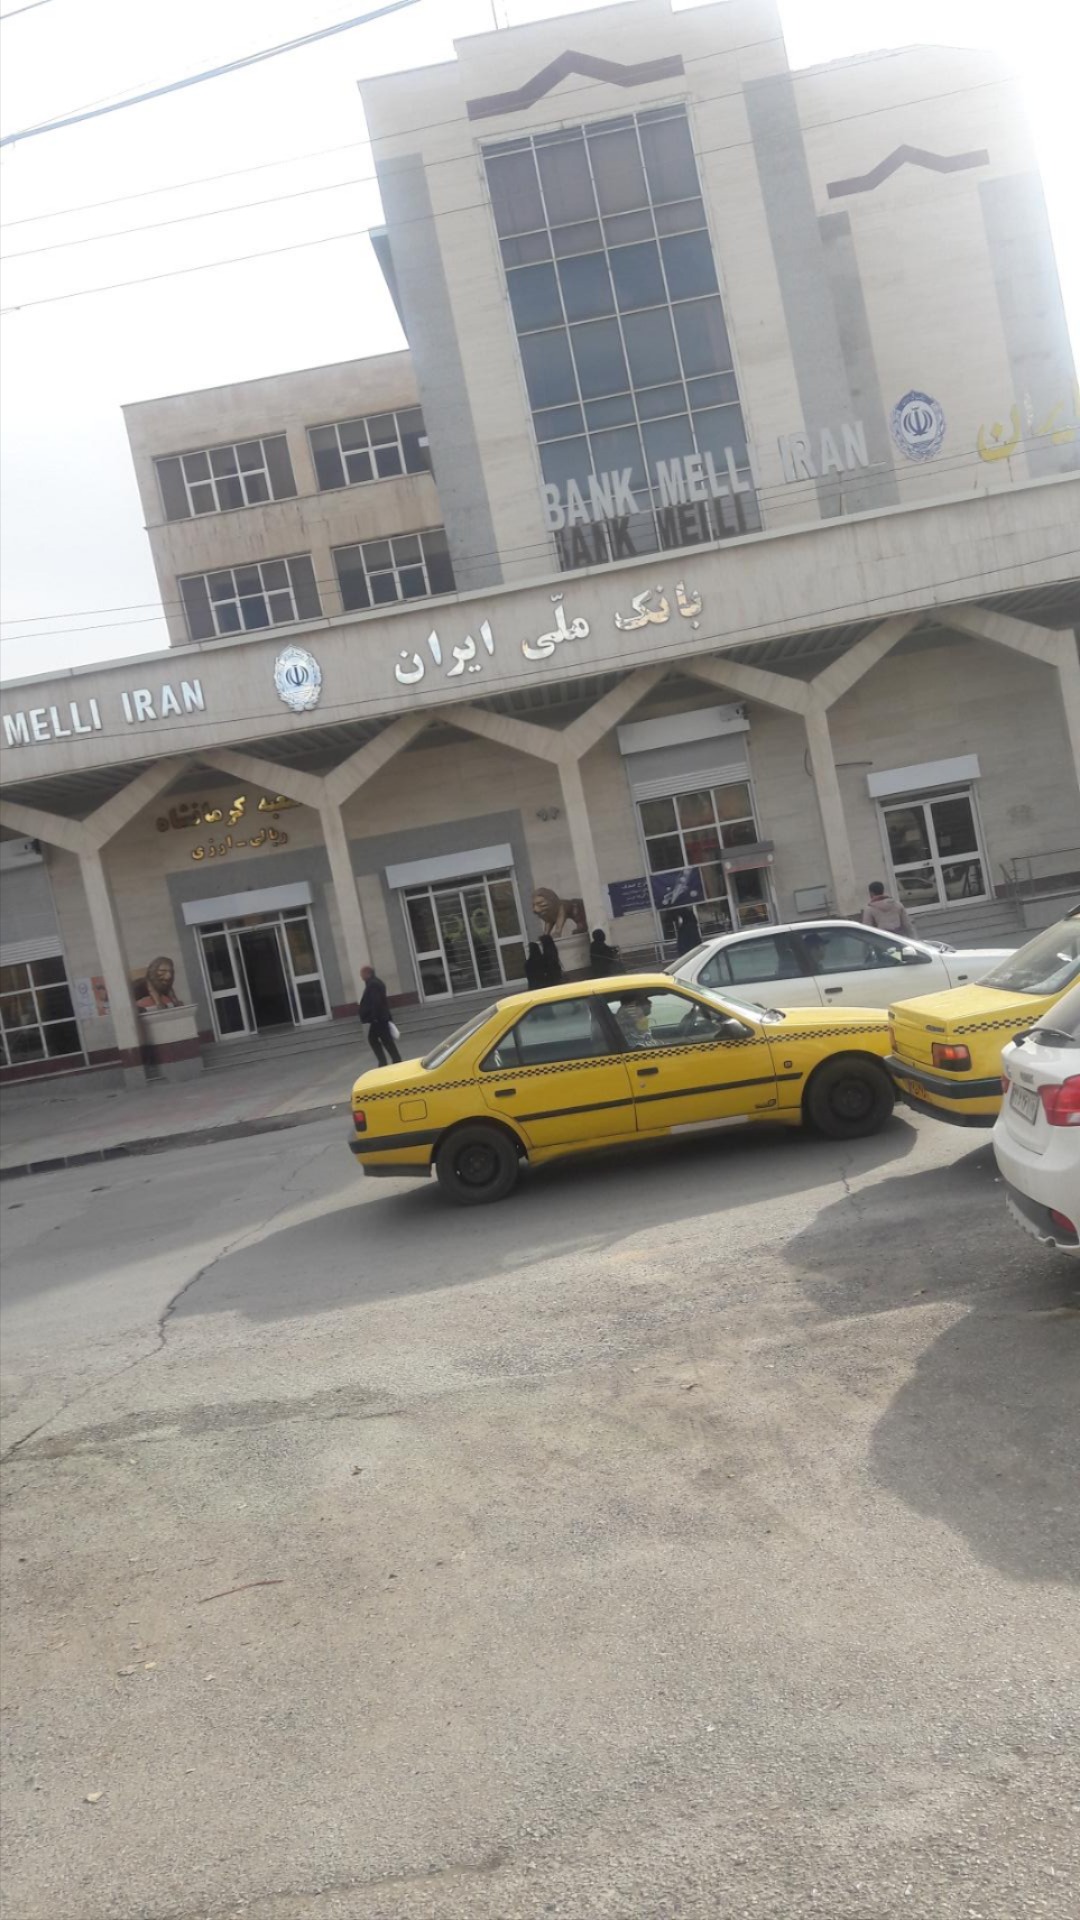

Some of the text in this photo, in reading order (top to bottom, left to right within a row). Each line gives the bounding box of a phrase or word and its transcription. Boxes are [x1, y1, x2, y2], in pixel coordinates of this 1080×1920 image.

[543, 420, 869, 532] BANK MELLI IRAN
[614, 580, 704, 631] بانک
[395, 619, 495, 685] ایران
[2, 679, 206, 746] MELLI IRAN
